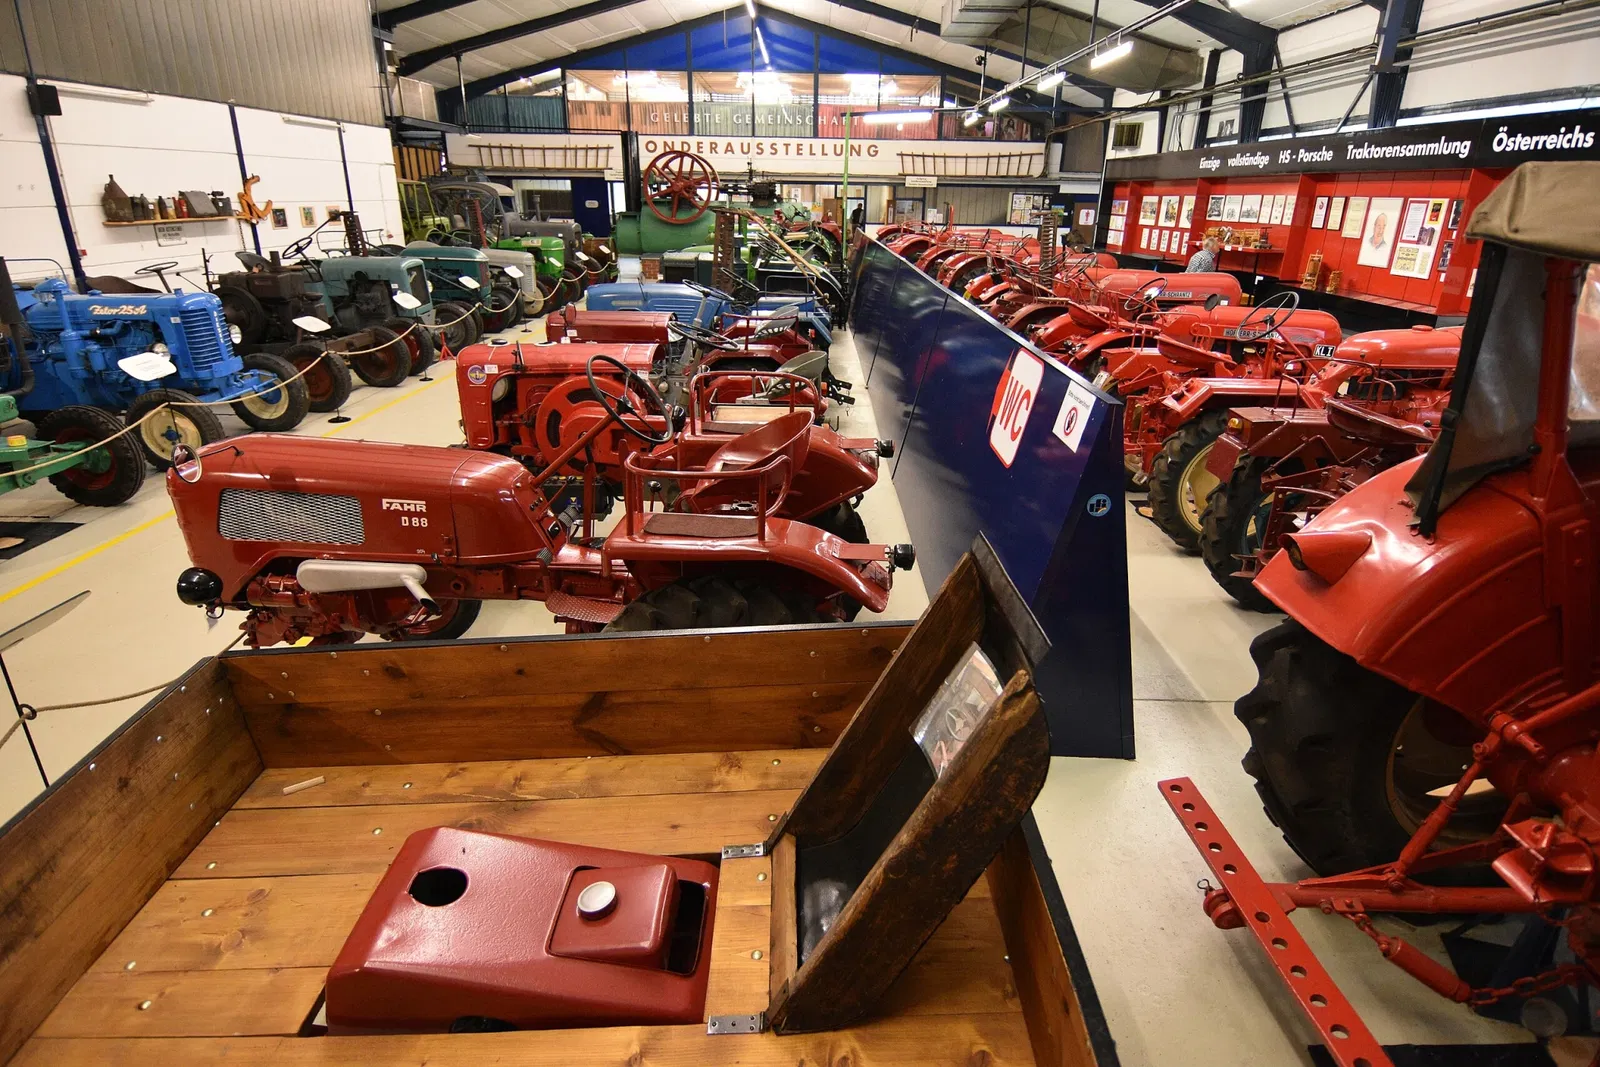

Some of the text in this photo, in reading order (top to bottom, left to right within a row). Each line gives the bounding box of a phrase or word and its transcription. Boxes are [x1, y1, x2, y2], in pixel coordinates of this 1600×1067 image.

[650, 112, 859, 126] GELEBTE GEMEINSCHAFT
[645, 140, 879, 157] ONDERAUSSTELLUNG
[1199, 157, 1221, 172] Einzige
[1227, 152, 1270, 170] vollständige
[1278, 150, 1291, 164] HS
[1297, 146, 1334, 163] Porsche
[1346, 135, 1471, 160] Traktorensammlung
[1492, 125, 1595, 152] Österreichs
[1000, 376, 1031, 442] WC
[382, 498, 427, 512] FAHR
